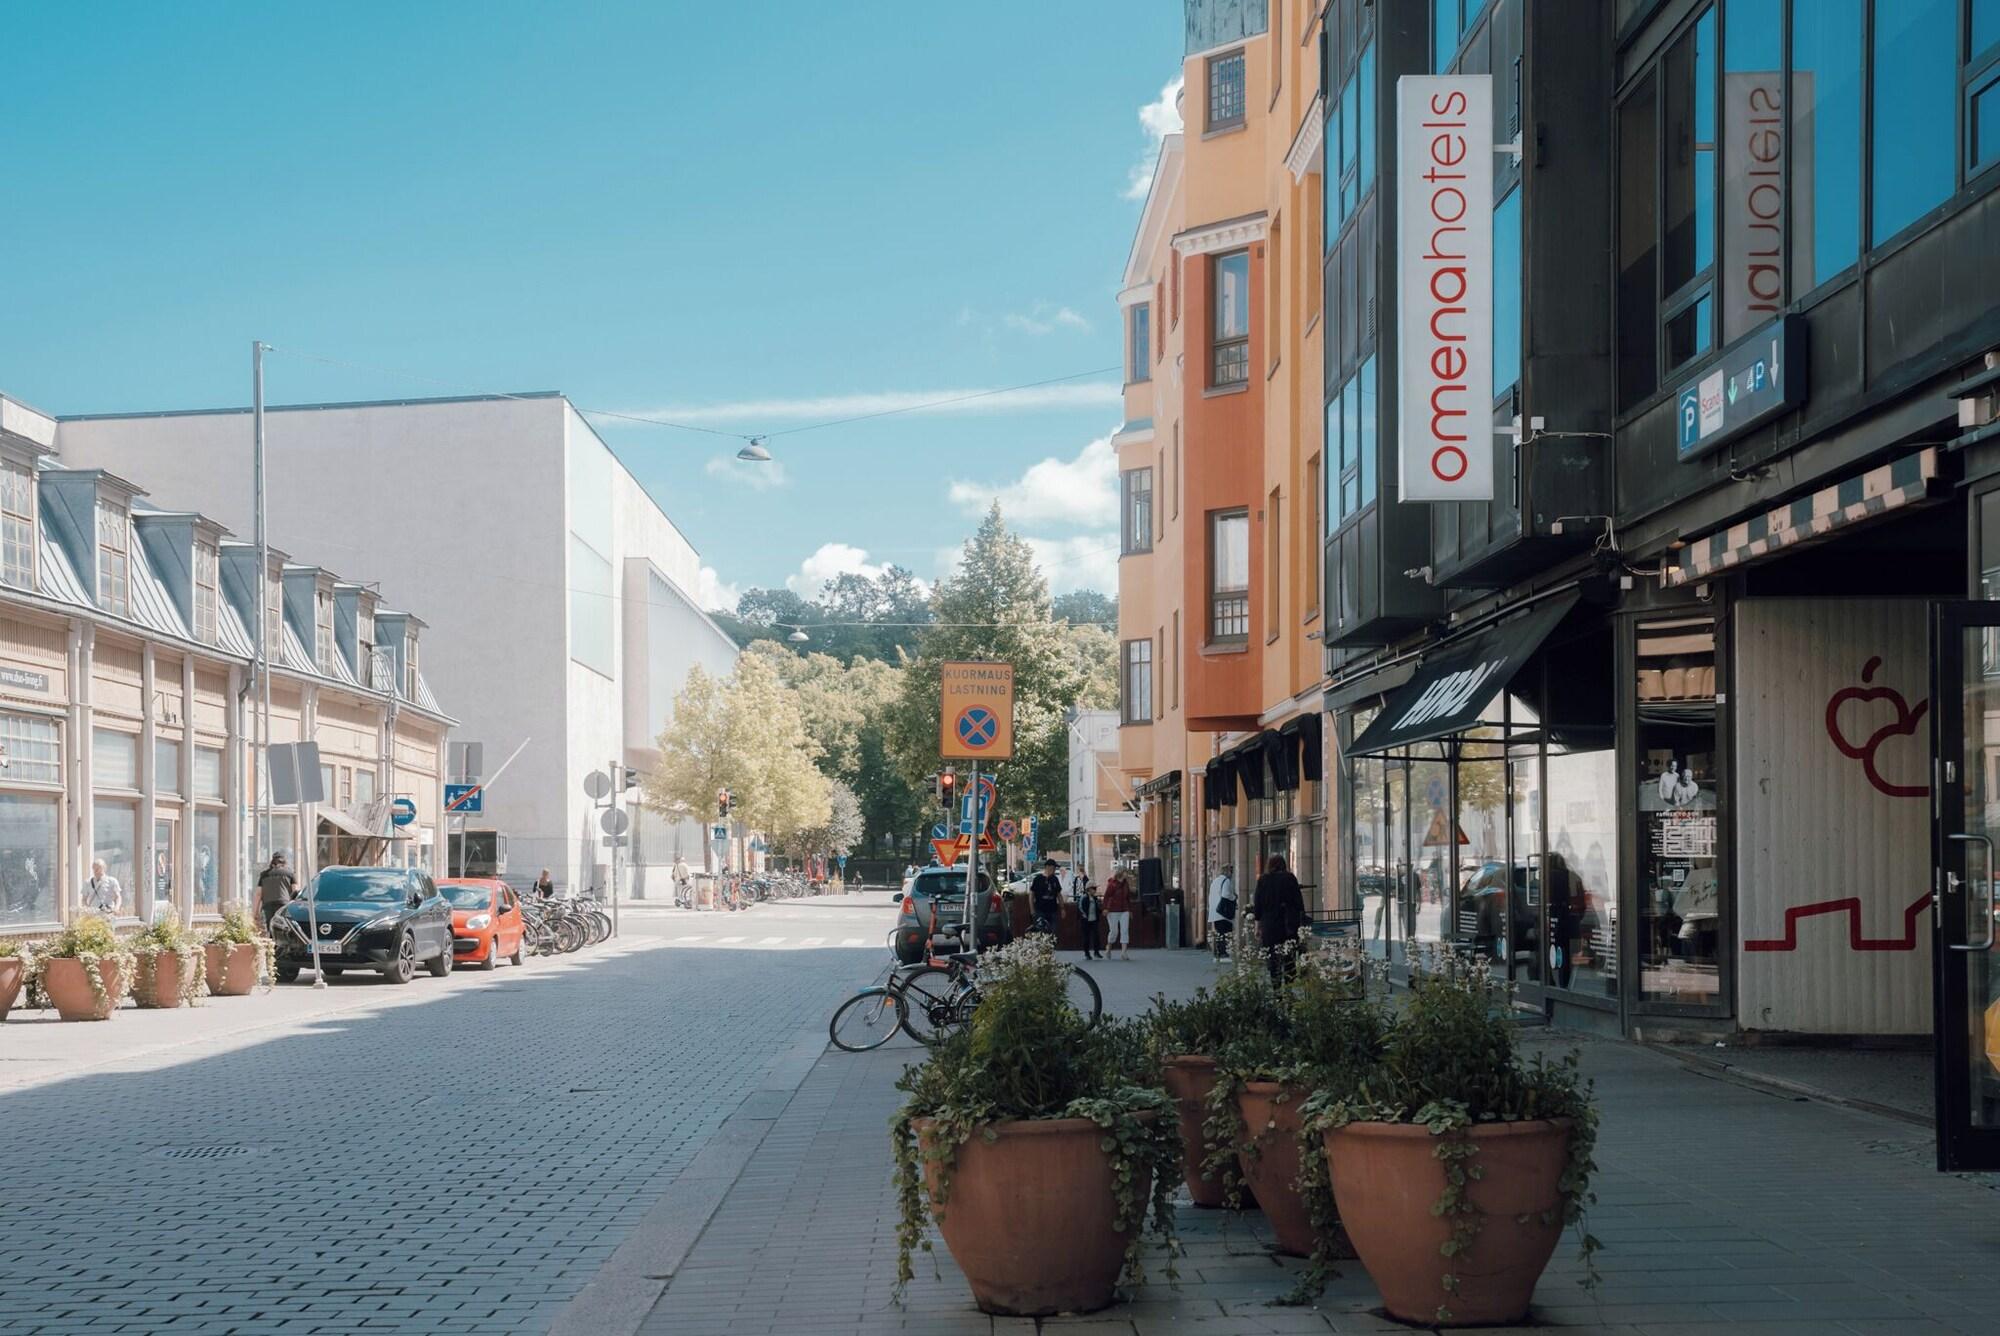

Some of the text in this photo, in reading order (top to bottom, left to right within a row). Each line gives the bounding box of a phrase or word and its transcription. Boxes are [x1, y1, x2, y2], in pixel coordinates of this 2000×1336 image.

[1422, 91, 1468, 482] omenahotels
[1686, 407, 1695, 441] P
[945, 669, 1010, 680] KUORMAUS
[950, 684, 1006, 695] LASTNING
